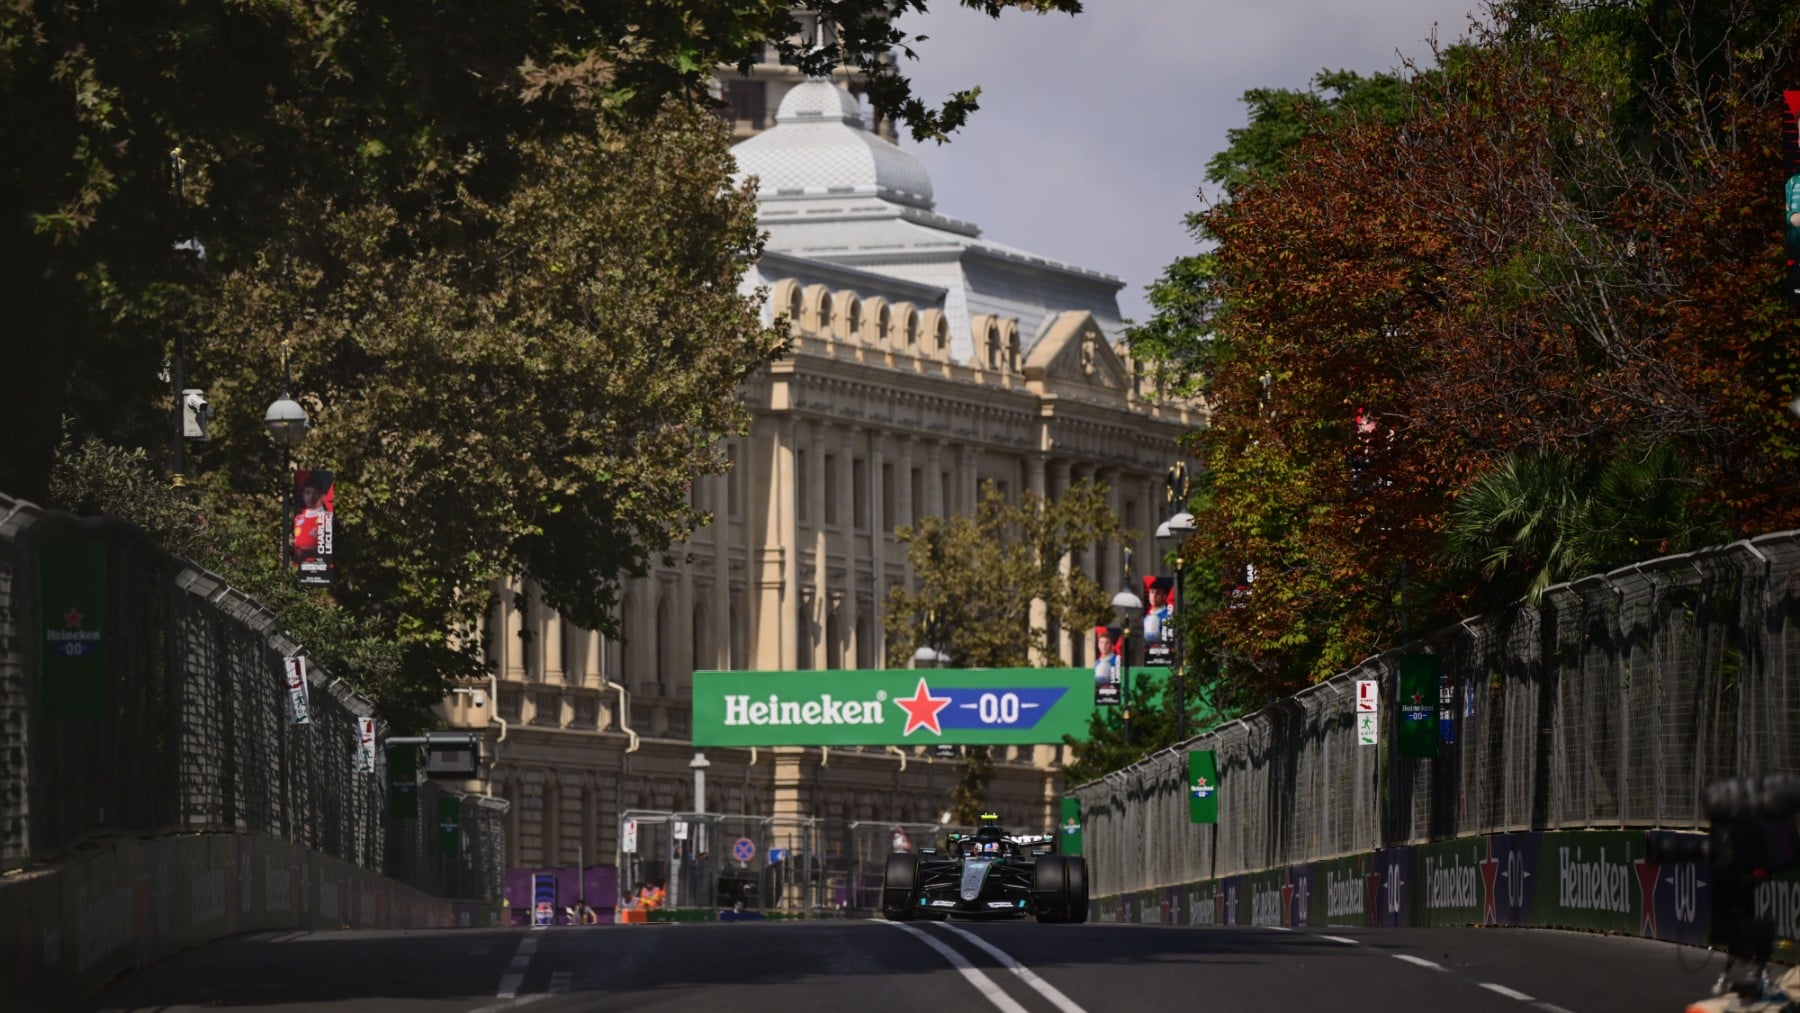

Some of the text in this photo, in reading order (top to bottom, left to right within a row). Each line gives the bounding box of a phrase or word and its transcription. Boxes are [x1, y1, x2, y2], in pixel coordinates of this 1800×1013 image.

[47, 628, 101, 641] Heineken
[724, 693, 885, 726] Heineken
[1327, 868, 1364, 917] Heineken
[1425, 853, 1477, 908] Heineken
[1559, 845, 1630, 913] Heineken
